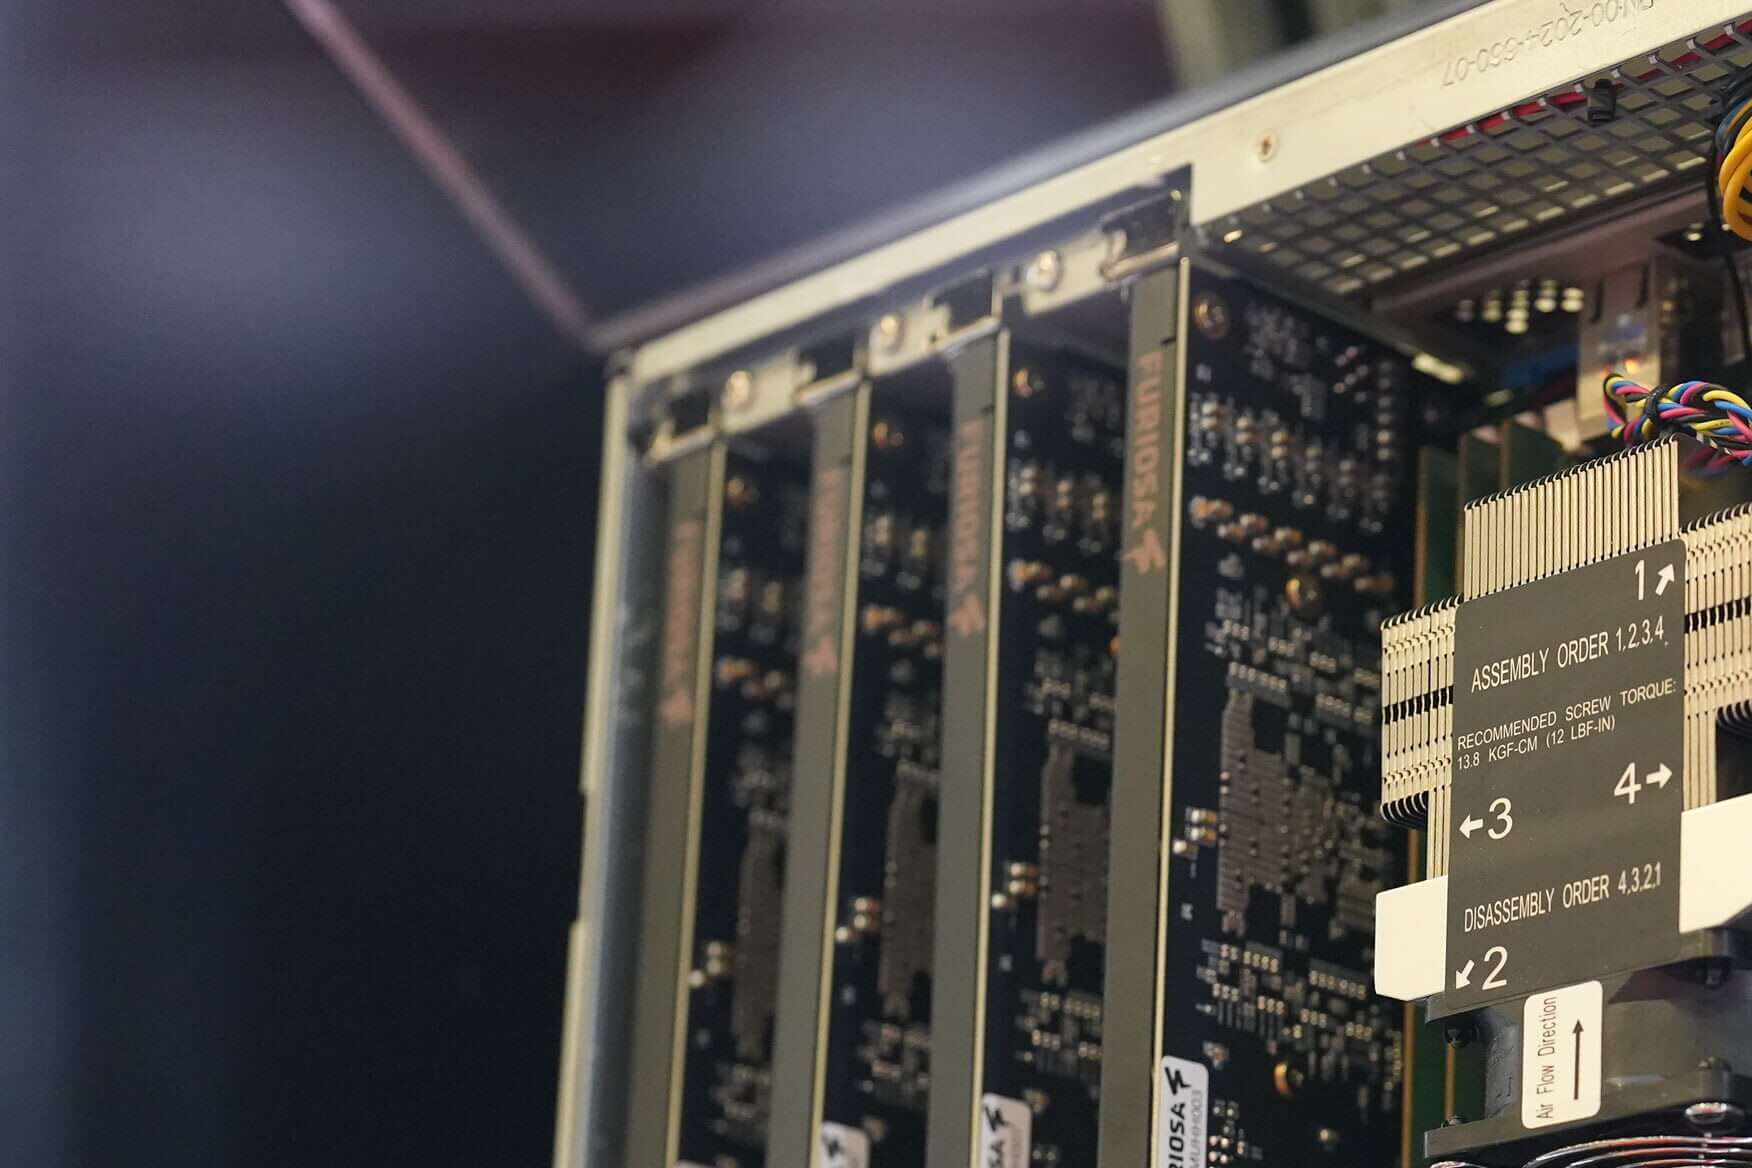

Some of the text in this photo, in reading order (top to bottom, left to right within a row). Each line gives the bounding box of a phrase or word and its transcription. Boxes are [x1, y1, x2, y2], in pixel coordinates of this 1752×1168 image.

[1635, 560, 1645, 600] 1
[1471, 648, 1549, 693] ASSEMBLY
[1557, 631, 1609, 668] ORDER
[1458, 678, 1677, 750] RECOMMENDED SCREW TORQUE:
[1457, 715, 1616, 770] 13.8 KGF-CM (12 LBF-IN)
[1614, 762, 1642, 804] 4
[1487, 797, 1513, 839] 3
[1464, 888, 1555, 932] DISASSEMBLY
[1563, 874, 1610, 908] ORDER
[1482, 946, 1508, 990] 2
[1536, 996, 1557, 1119] Air Flow Direction
